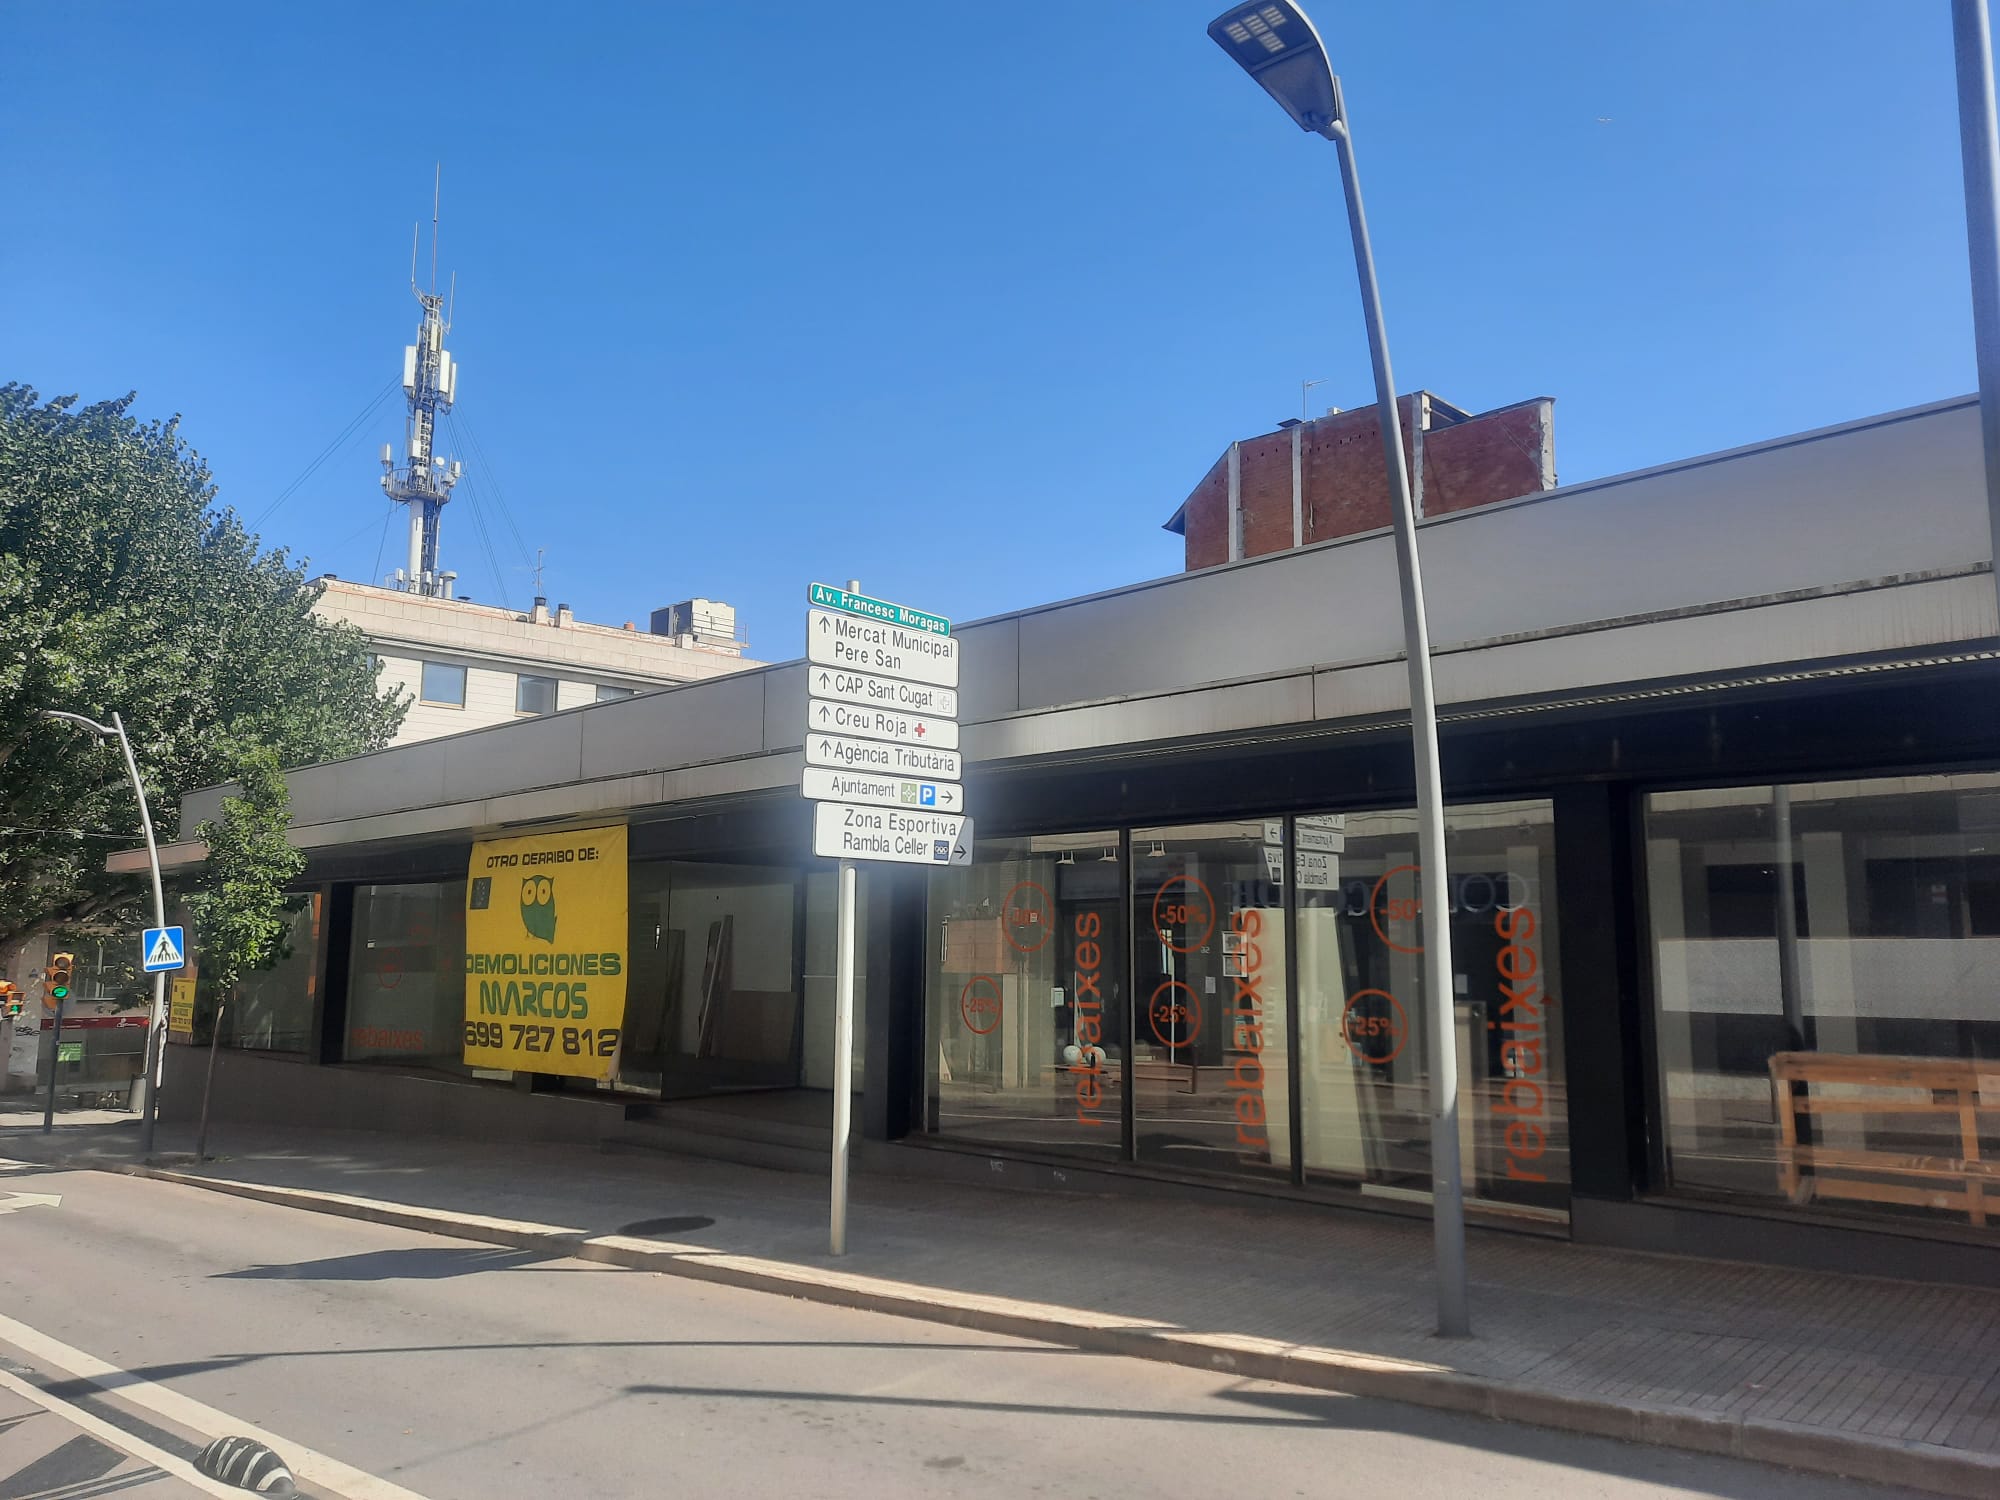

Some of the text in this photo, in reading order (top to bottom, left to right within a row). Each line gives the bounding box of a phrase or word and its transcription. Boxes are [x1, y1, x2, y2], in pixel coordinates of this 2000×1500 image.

[815, 586, 946, 633] Av. Francesc Moragas
[836, 618, 953, 659] Mercat Municipal
[835, 641, 901, 670] Pere San
[835, 674, 933, 709] CAP Sant Cugat
[835, 707, 907, 737] Creu Roja
[834, 741, 955, 772] Agència Tributària
[831, 776, 895, 797] Ajuntament
[843, 808, 957, 836] Zona Esportiva
[486, 847, 600, 868] OTRO DERRIBO DE:
[843, 831, 928, 856] Rambla Celler
[1160, 905, 1207, 924] -50%
[479, 979, 589, 1020] MARCOS
[1154, 1004, 1196, 1024] -25%
[1067, 911, 1102, 1127] rebaixes
[1223, 909, 1270, 1148] rebaixes
[464, 1020, 622, 1057] 699 727 812
[1487, 907, 1547, 1183] rebaixes
